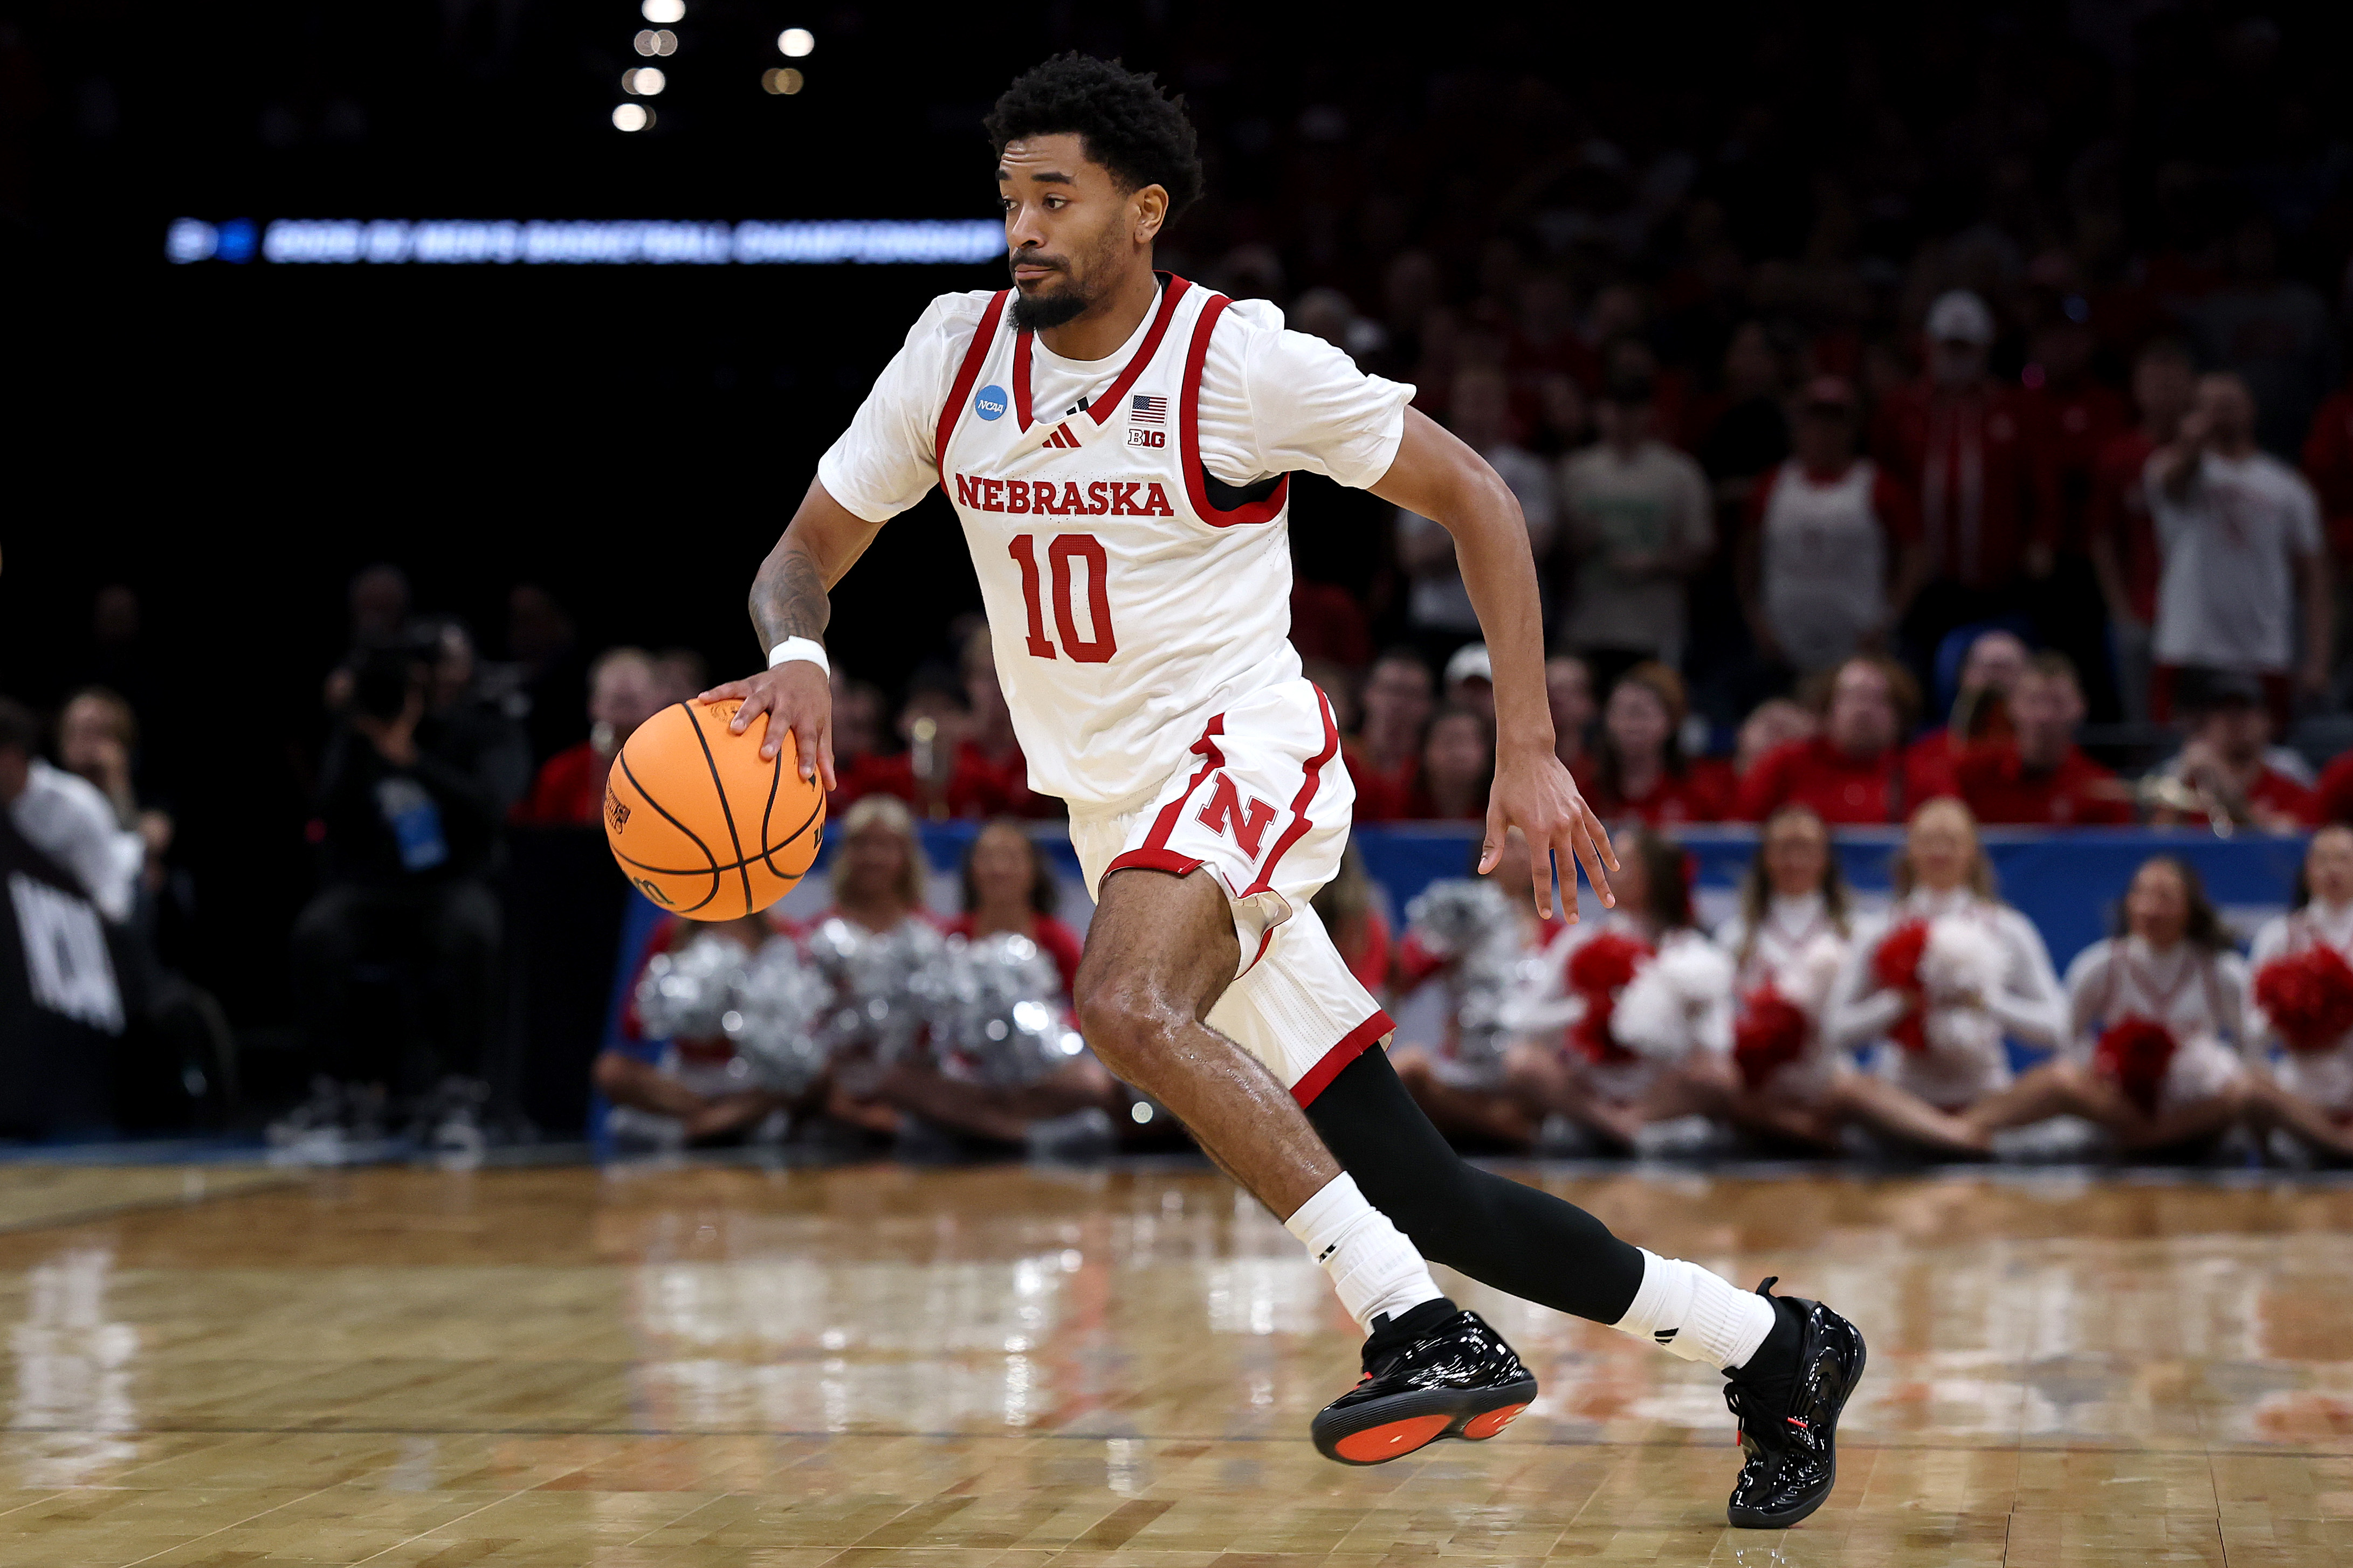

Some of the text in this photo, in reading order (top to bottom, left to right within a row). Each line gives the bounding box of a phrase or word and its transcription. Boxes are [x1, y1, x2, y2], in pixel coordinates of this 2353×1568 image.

[978, 399, 1004, 413] NCAA
[955, 473, 1174, 516] NEBRASKA
[1008, 534, 1118, 663] 10
[1195, 769, 1279, 865] N
